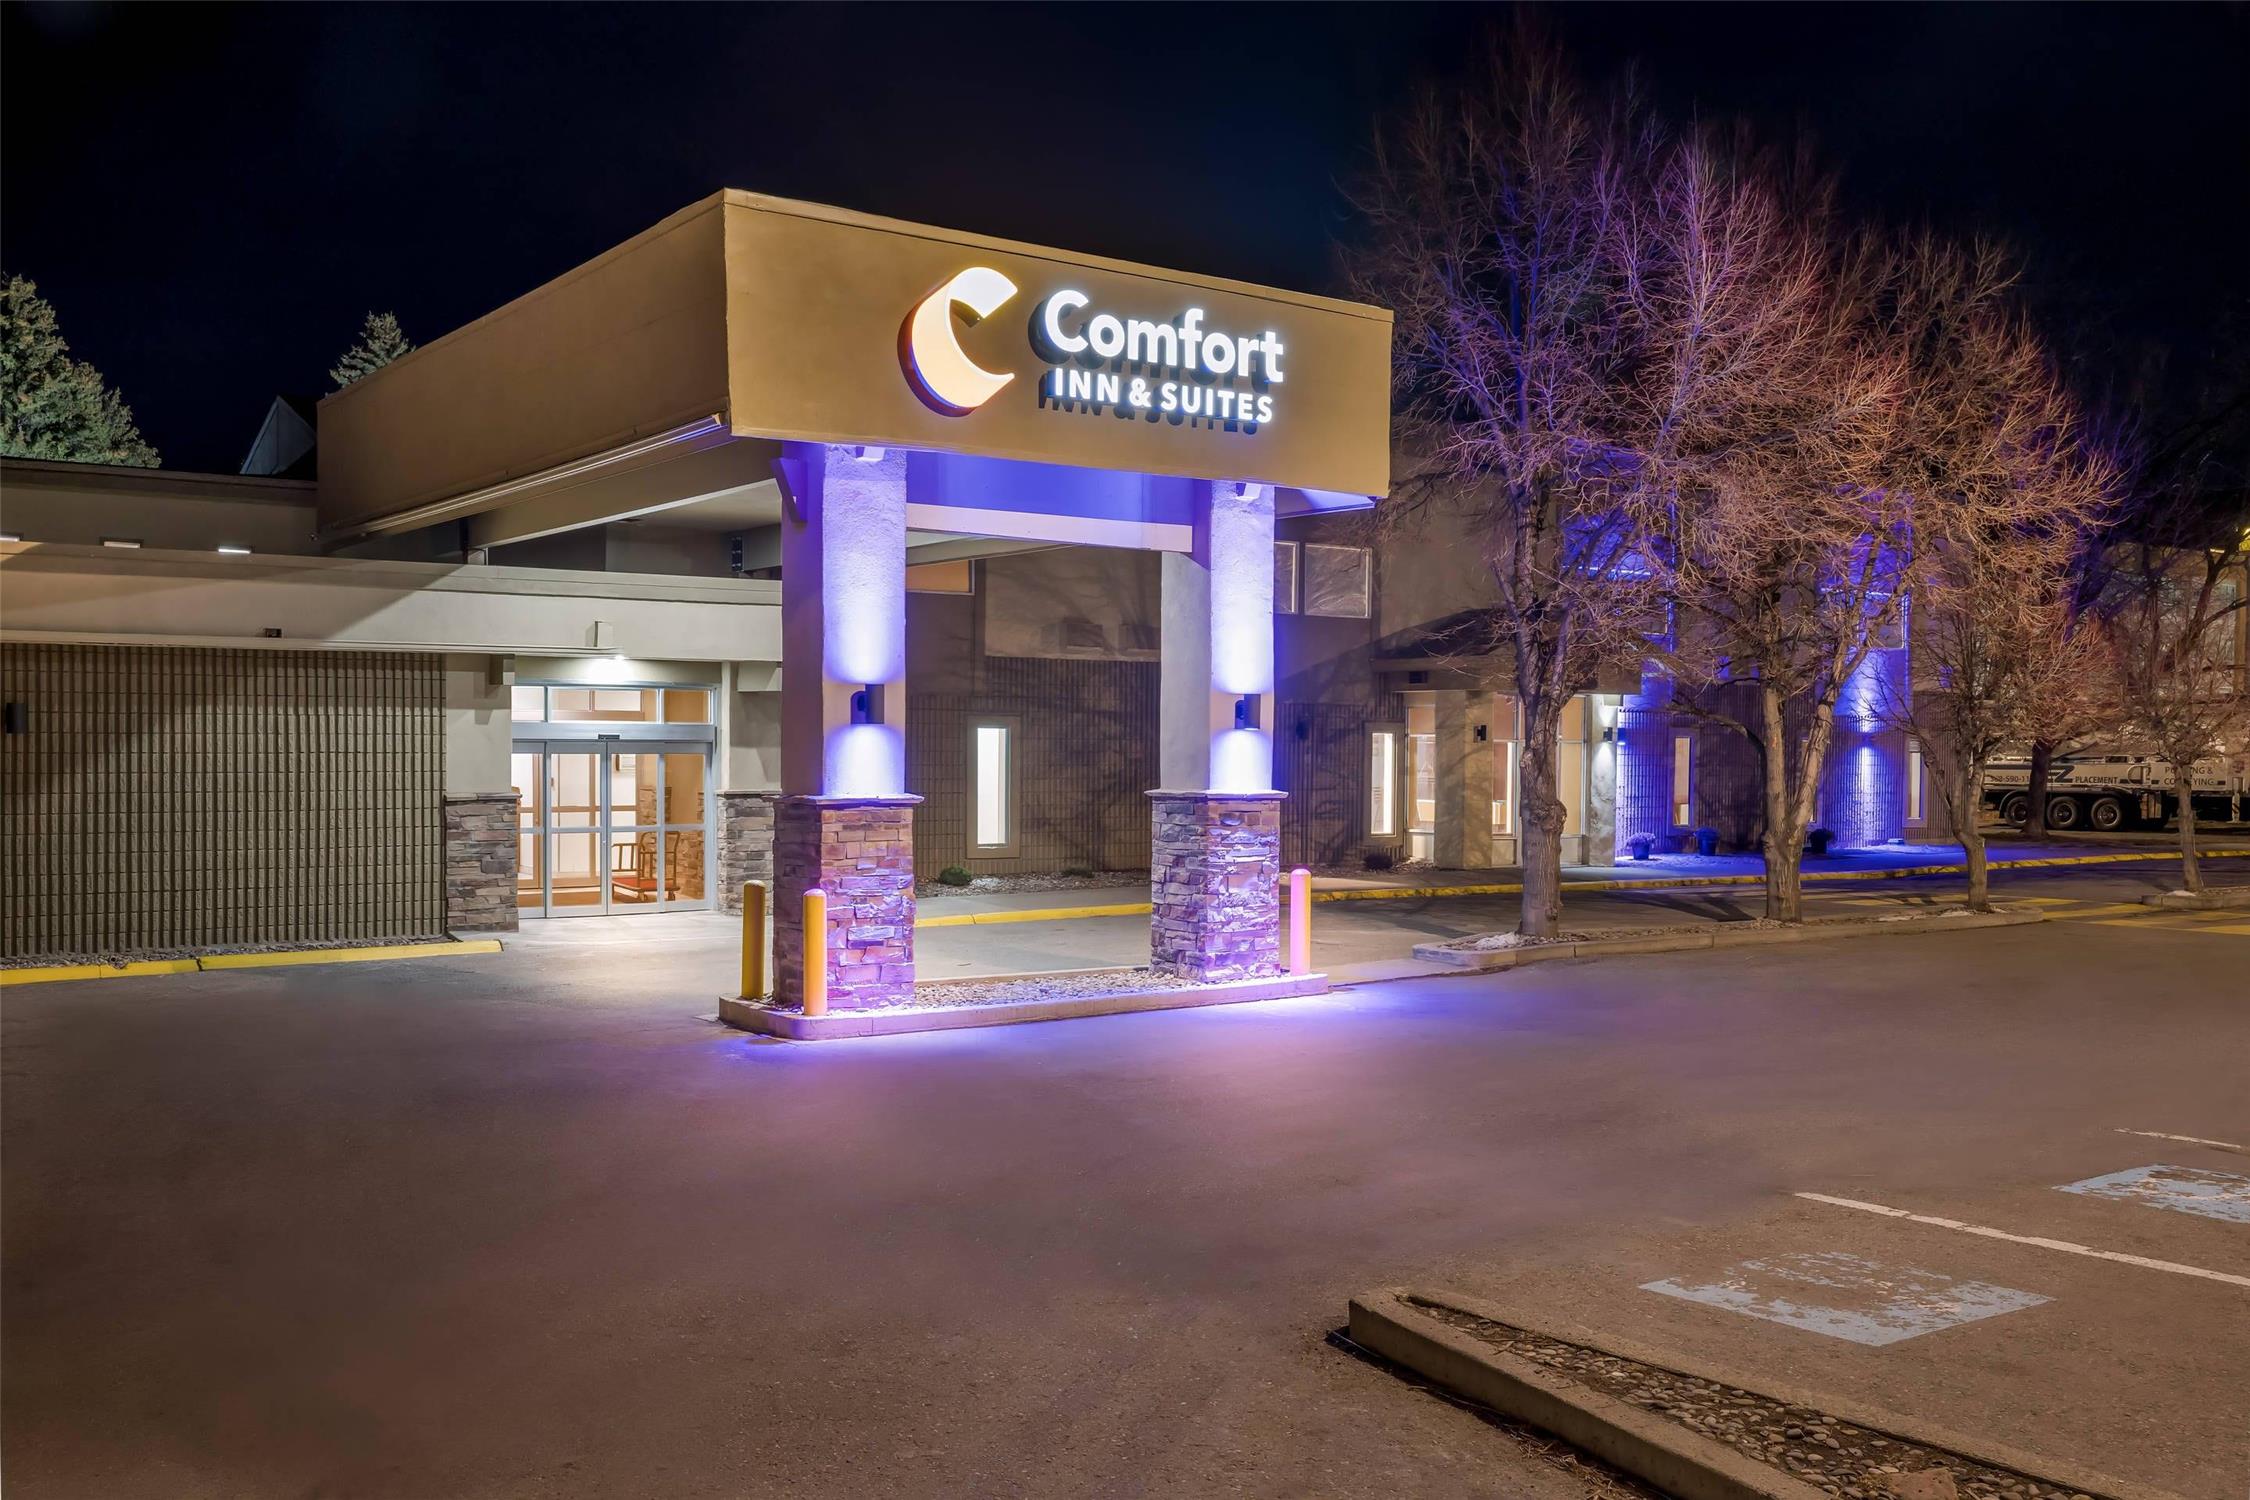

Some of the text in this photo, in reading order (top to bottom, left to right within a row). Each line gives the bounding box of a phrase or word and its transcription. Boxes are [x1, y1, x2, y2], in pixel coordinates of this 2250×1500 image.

[1044, 289, 1284, 383] Comfort
[1054, 368, 1274, 424] INN & SUITES
[2075, 776, 2118, 784] PLACEMENT
